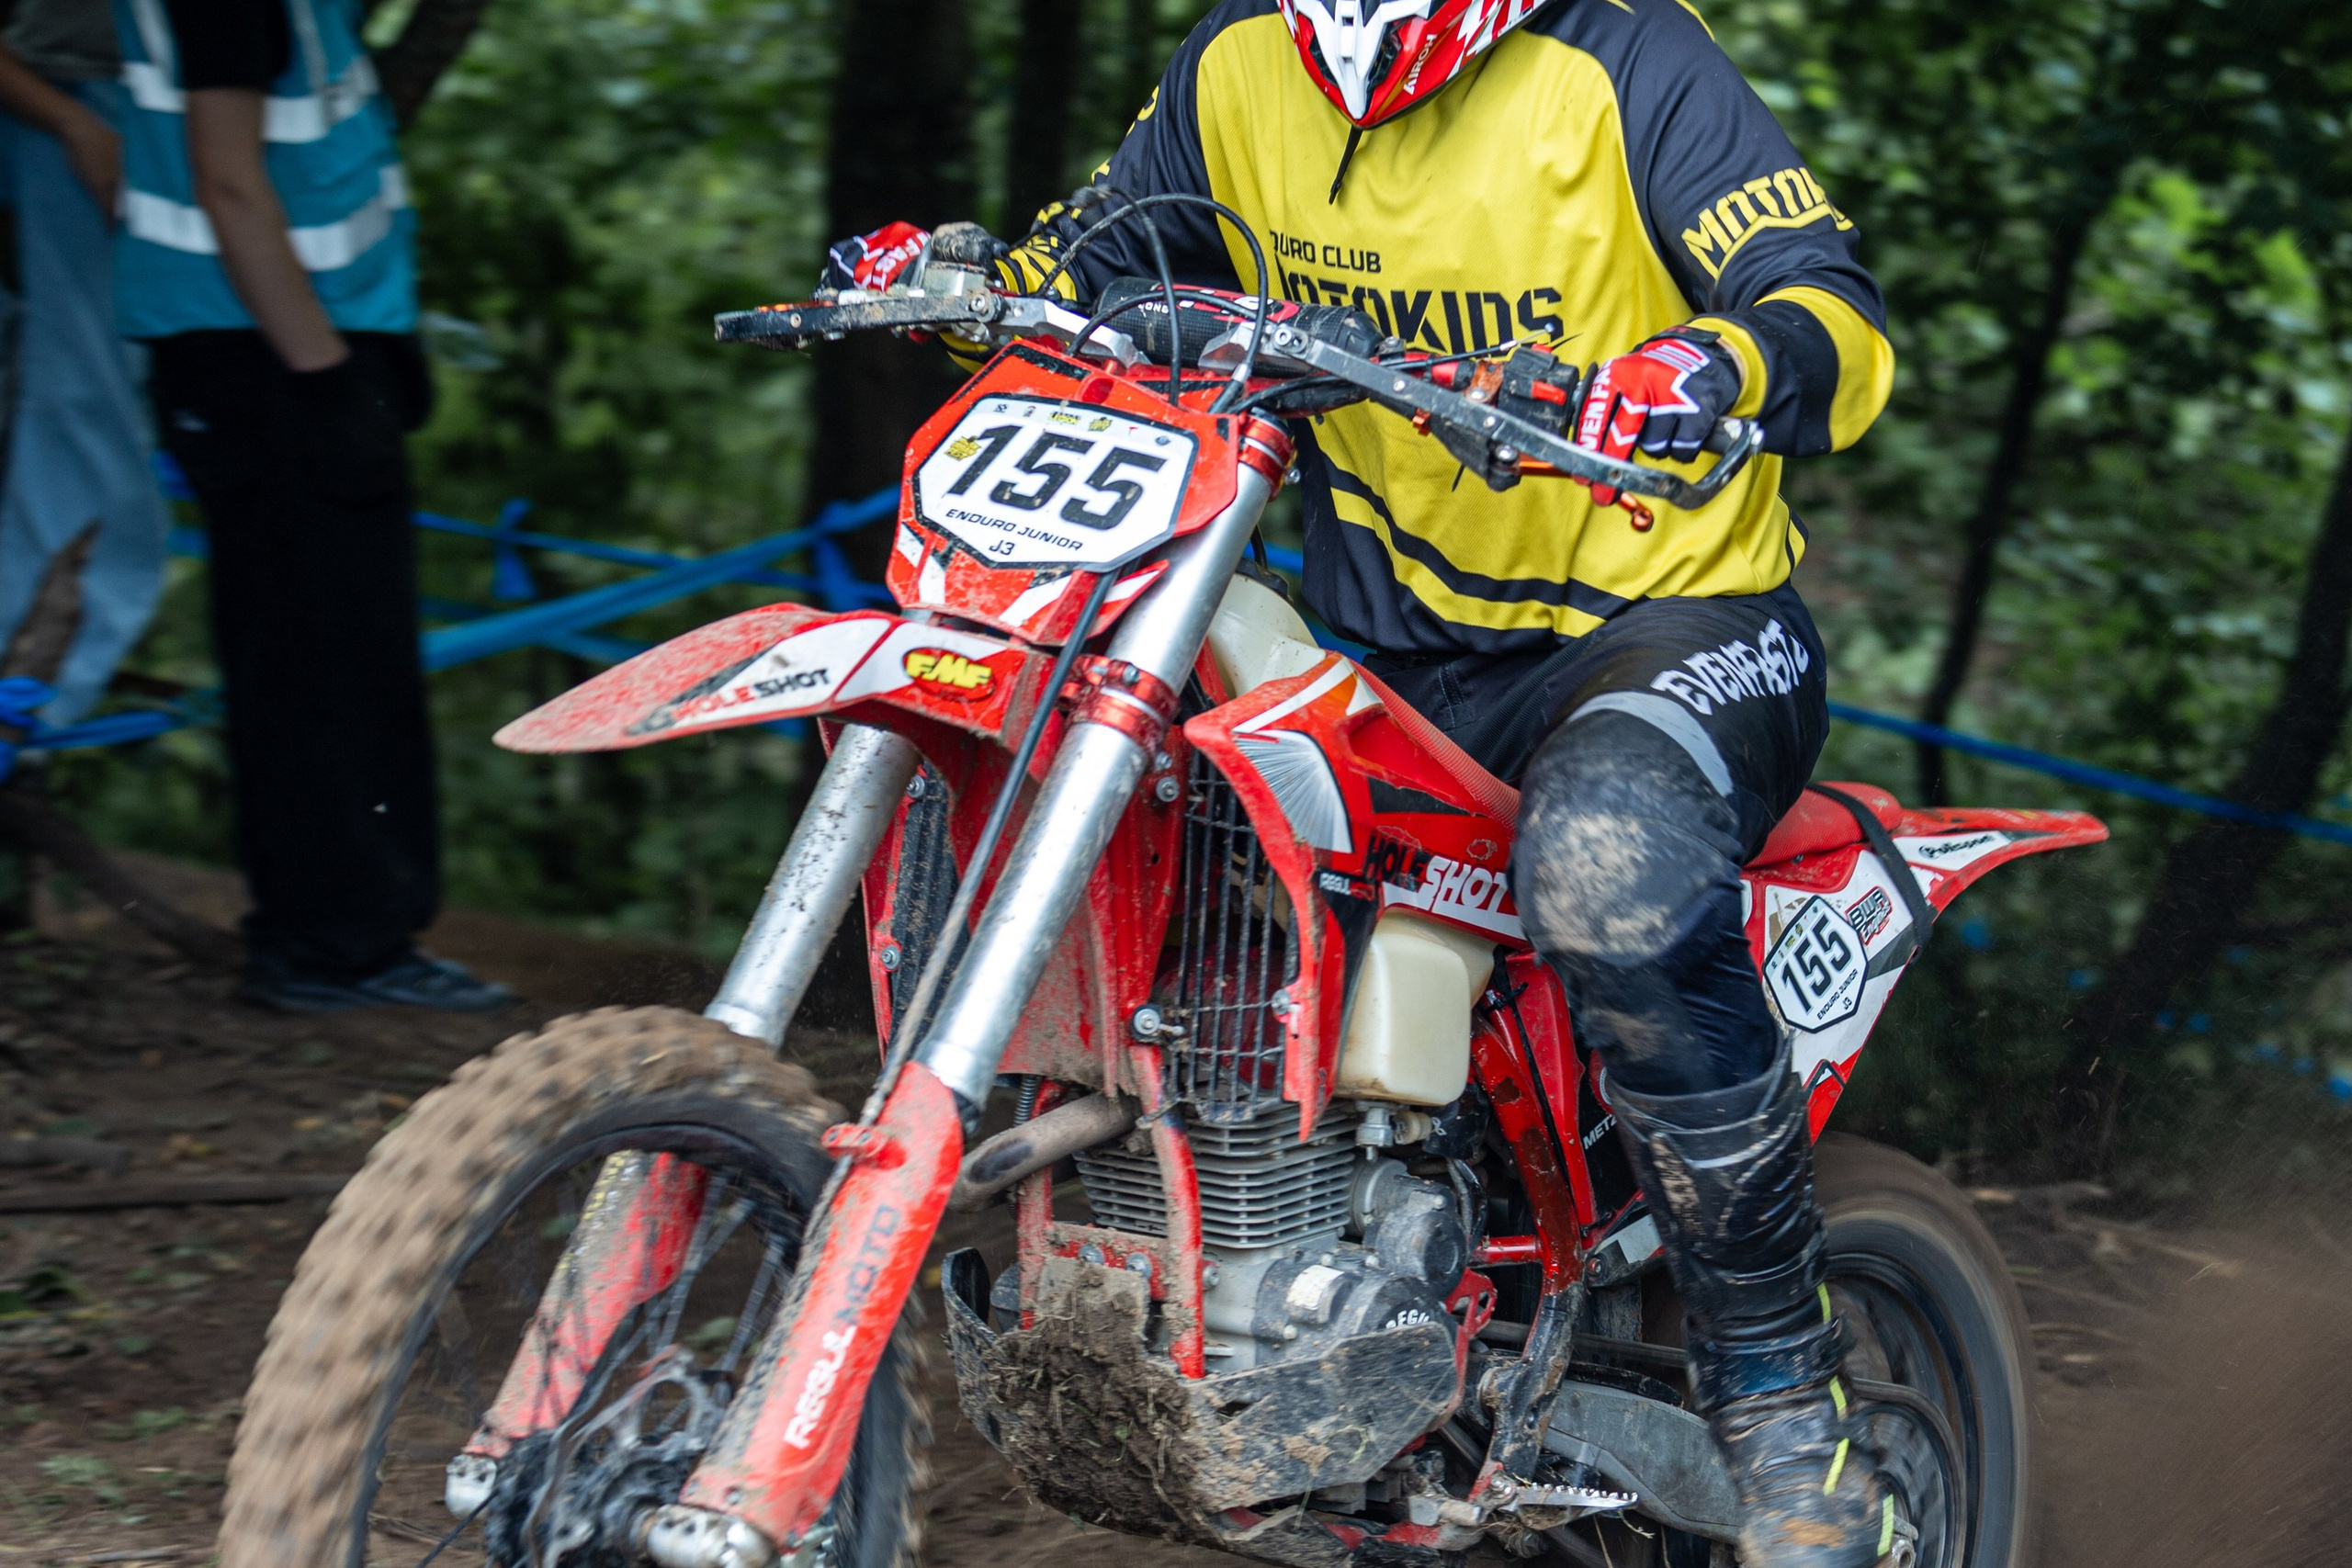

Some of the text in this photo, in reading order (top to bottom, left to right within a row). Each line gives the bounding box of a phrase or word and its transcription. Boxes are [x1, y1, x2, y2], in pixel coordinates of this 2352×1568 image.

[1403, 34, 1438, 96] AIROH
[1322, 245, 1381, 273] CLUB
[1274, 254, 1565, 357] OTOKIDS
[947, 423, 1169, 531] 155
[945, 508, 1083, 551] ENDURO JUNIOR
[989, 540, 1015, 556] J3
[906, 653, 992, 690] FMF
[1781, 913, 1853, 1013] 155
[1816, 968, 1858, 1021] ENDURO JUNIOR
[1842, 997, 1853, 1010] J3
